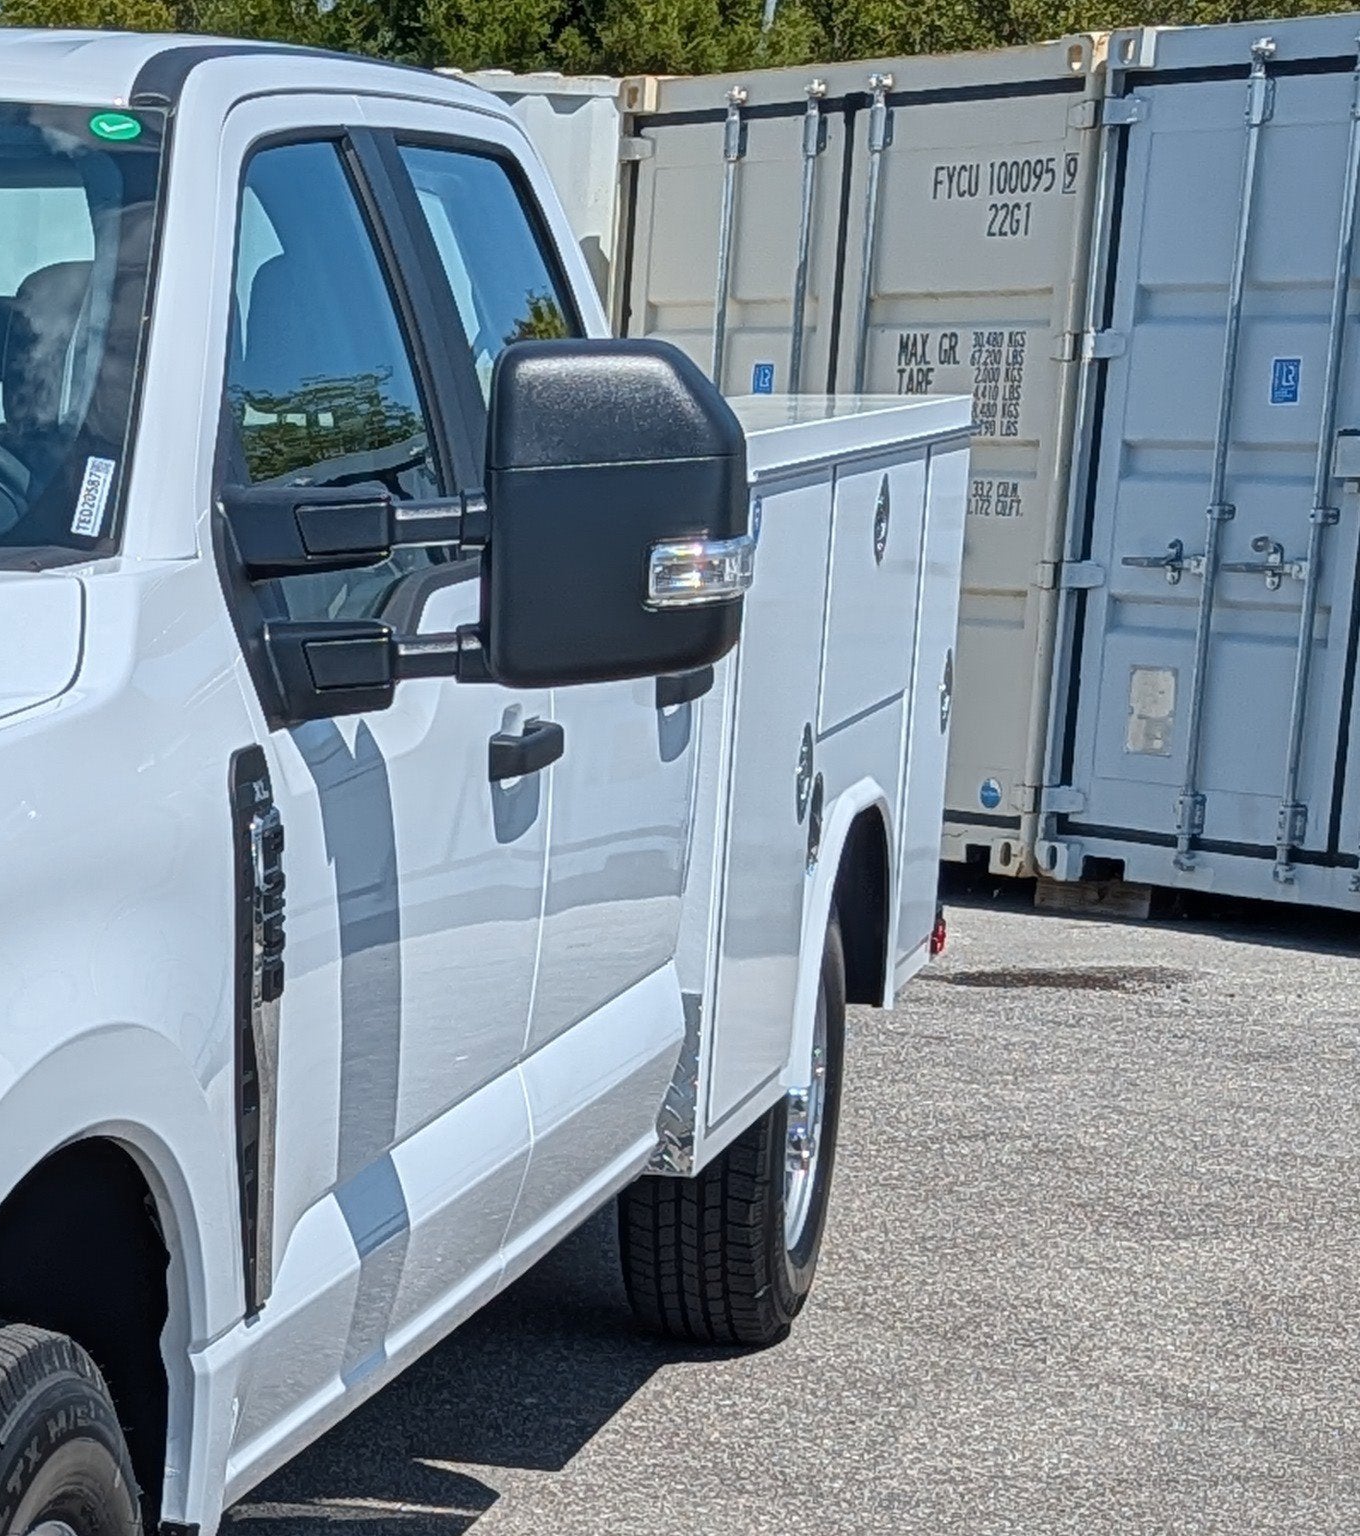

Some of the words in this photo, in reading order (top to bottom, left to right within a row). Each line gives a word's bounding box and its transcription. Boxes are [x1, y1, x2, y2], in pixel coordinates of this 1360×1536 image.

[932, 164, 980, 199] FYCU
[989, 157, 1056, 195] 100095
[986, 202, 1032, 236] 22G1
[252, 780, 270, 803] XL
